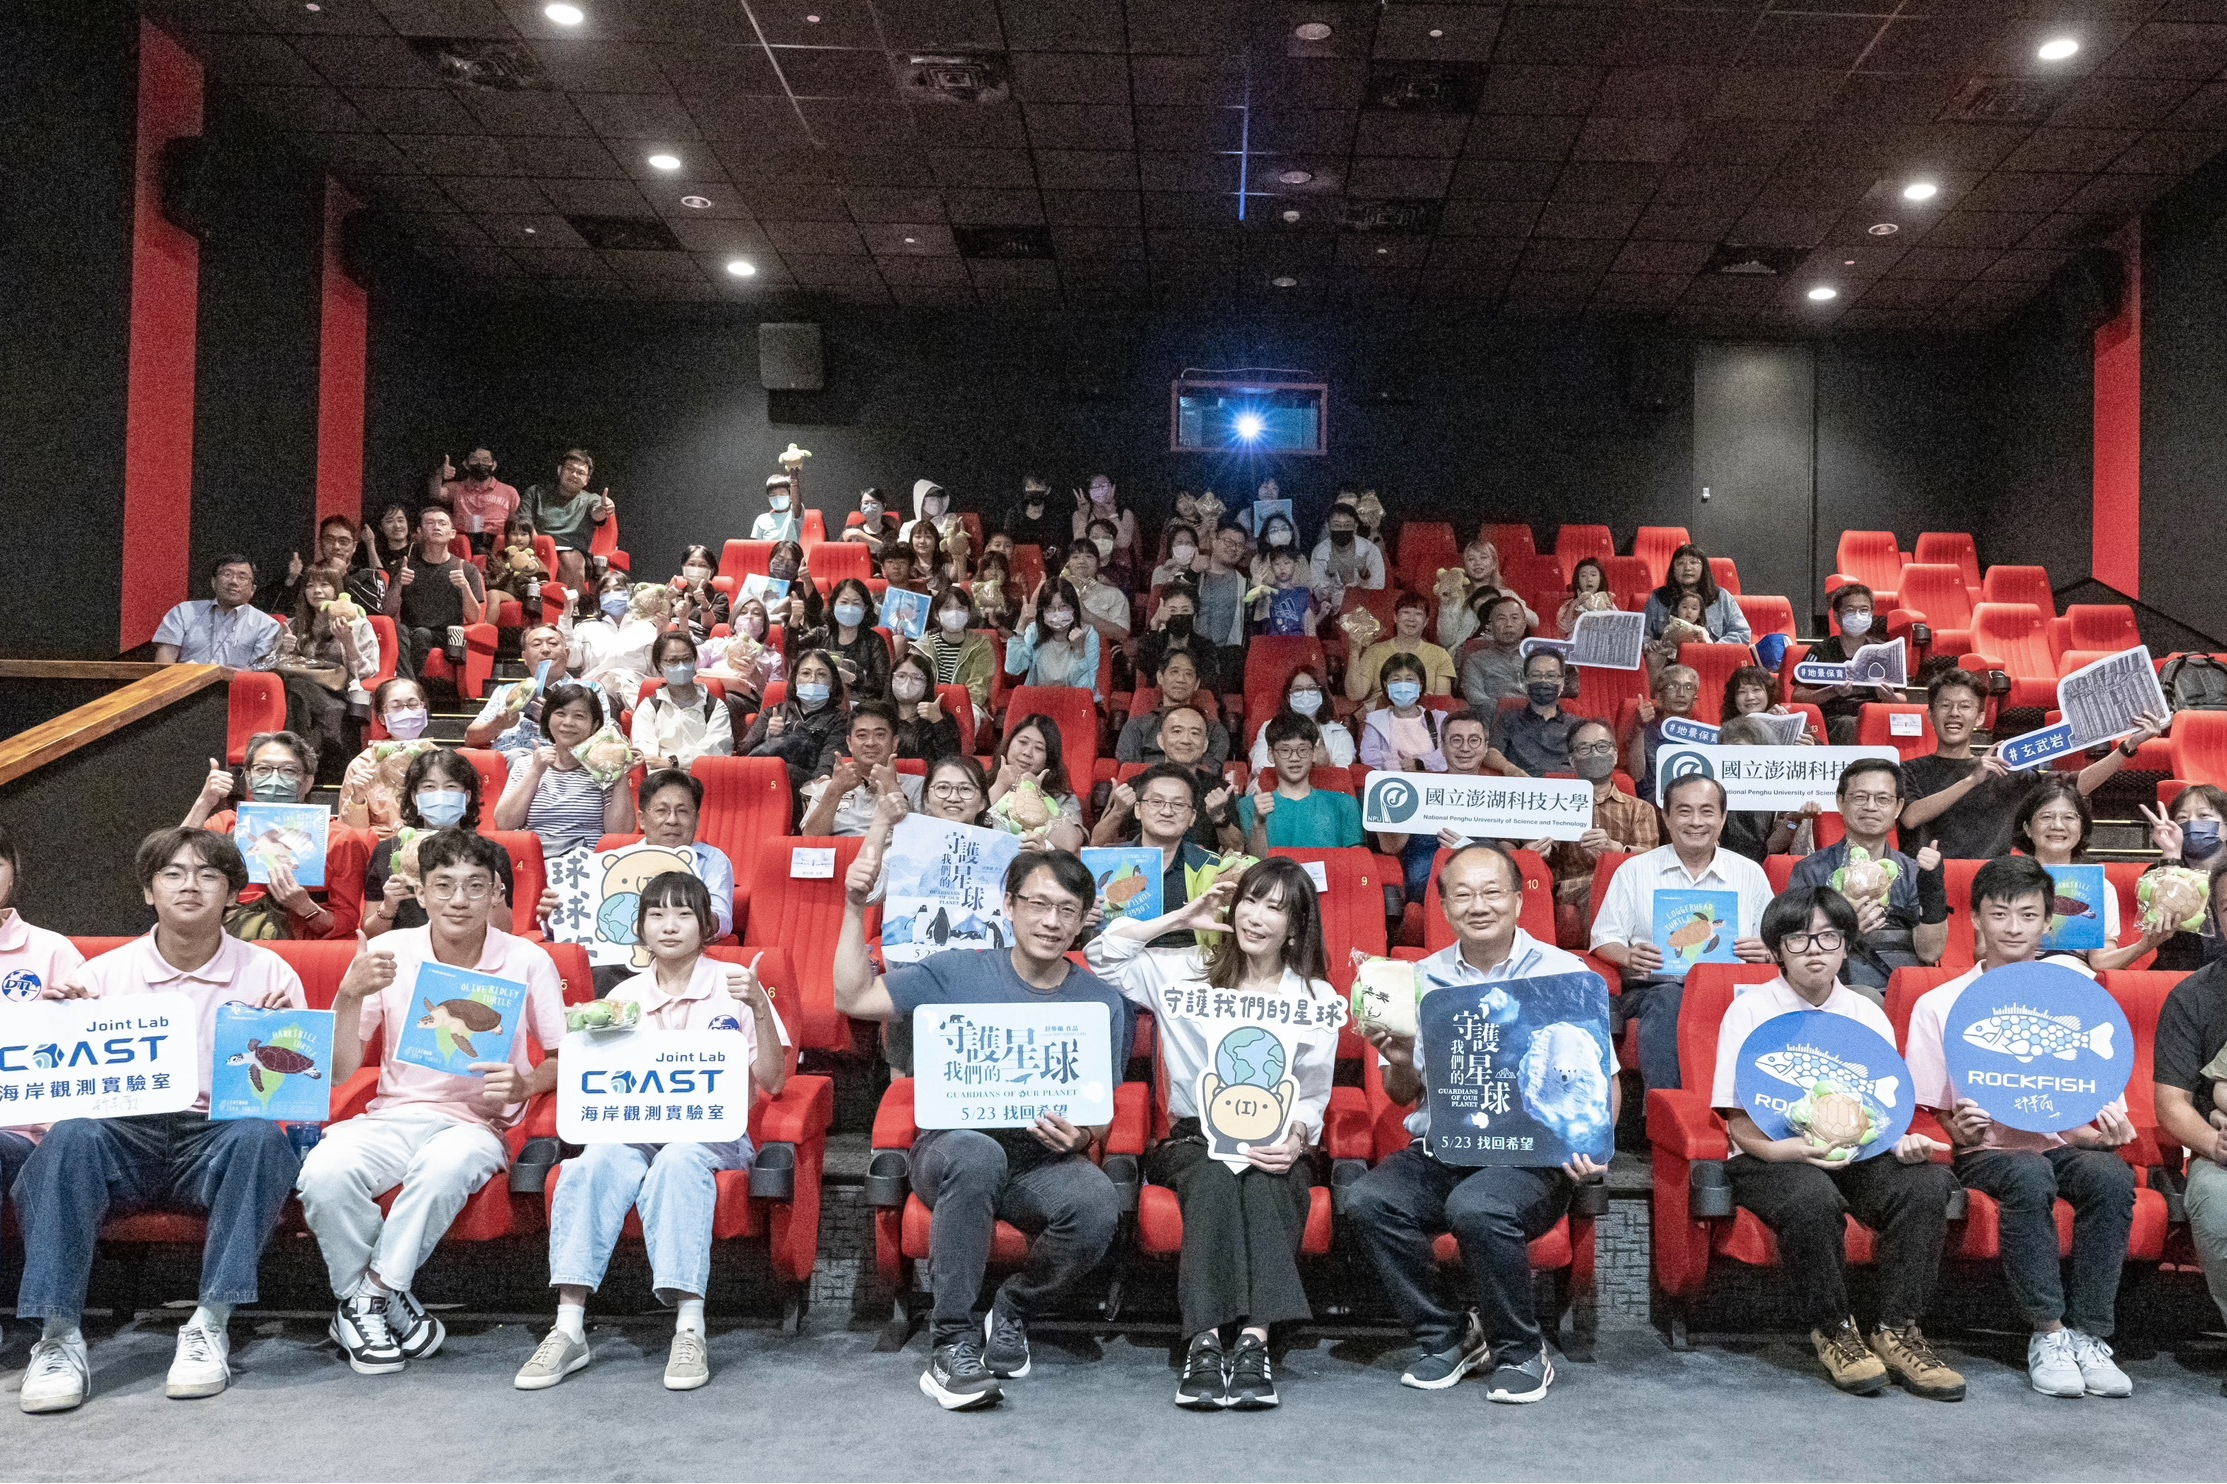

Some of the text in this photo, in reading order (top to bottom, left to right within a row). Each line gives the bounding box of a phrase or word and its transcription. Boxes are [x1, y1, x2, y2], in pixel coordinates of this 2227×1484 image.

[260, 692, 267, 700] 2
[956, 705, 961, 713] 6
[1081, 709, 1087, 717] 7
[484, 774, 490, 784] 3
[770, 780, 777, 790] 5
[1425, 787, 1589, 813] 國立澎湖科技大學
[1773, 789, 1806, 797] University
[1449, 815, 1473, 823] Penghu
[1473, 816, 1504, 825] University
[1552, 819, 1588, 828] Technology
[516, 860, 524, 870] 4
[1361, 876, 1368, 886] 9
[1526, 879, 1539, 890] 10
[1665, 903, 1714, 920] LOGGERHEAD
[1664, 915, 1691, 932] TURTLE
[460, 983, 520, 999] OLIVE RIDLEY
[560, 978, 568, 991] 5
[767, 987, 776, 999] 6
[482, 995, 513, 1008] TURTLE
[1164, 986, 1343, 1028] 守護我們的星球
[86, 1016, 169, 1033] Joint Lab
[272, 1029, 318, 1044] HAWKSBILL
[0, 1035, 169, 1072] COAST
[293, 1041, 317, 1057] TURTLE
[656, 1051, 726, 1063] Joint Lab
[1450, 1039, 1465, 1085] 我們的
[943, 1060, 1001, 1086] 我們的
[0, 1072, 171, 1102] 海岸觀測實驗室
[581, 1069, 725, 1094] COAST
[1968, 1069, 2096, 1094] ROCKFISH
[946, 1088, 1079, 1099] GUARDIANS OF OUR PLANET
[1438, 1087, 1479, 1095] GUARDIANS
[580, 1104, 725, 1122] 海岸觀測實驗室
[961, 1106, 997, 1121] 5/23
[1441, 1135, 1534, 1151] 5/23 找回希望
